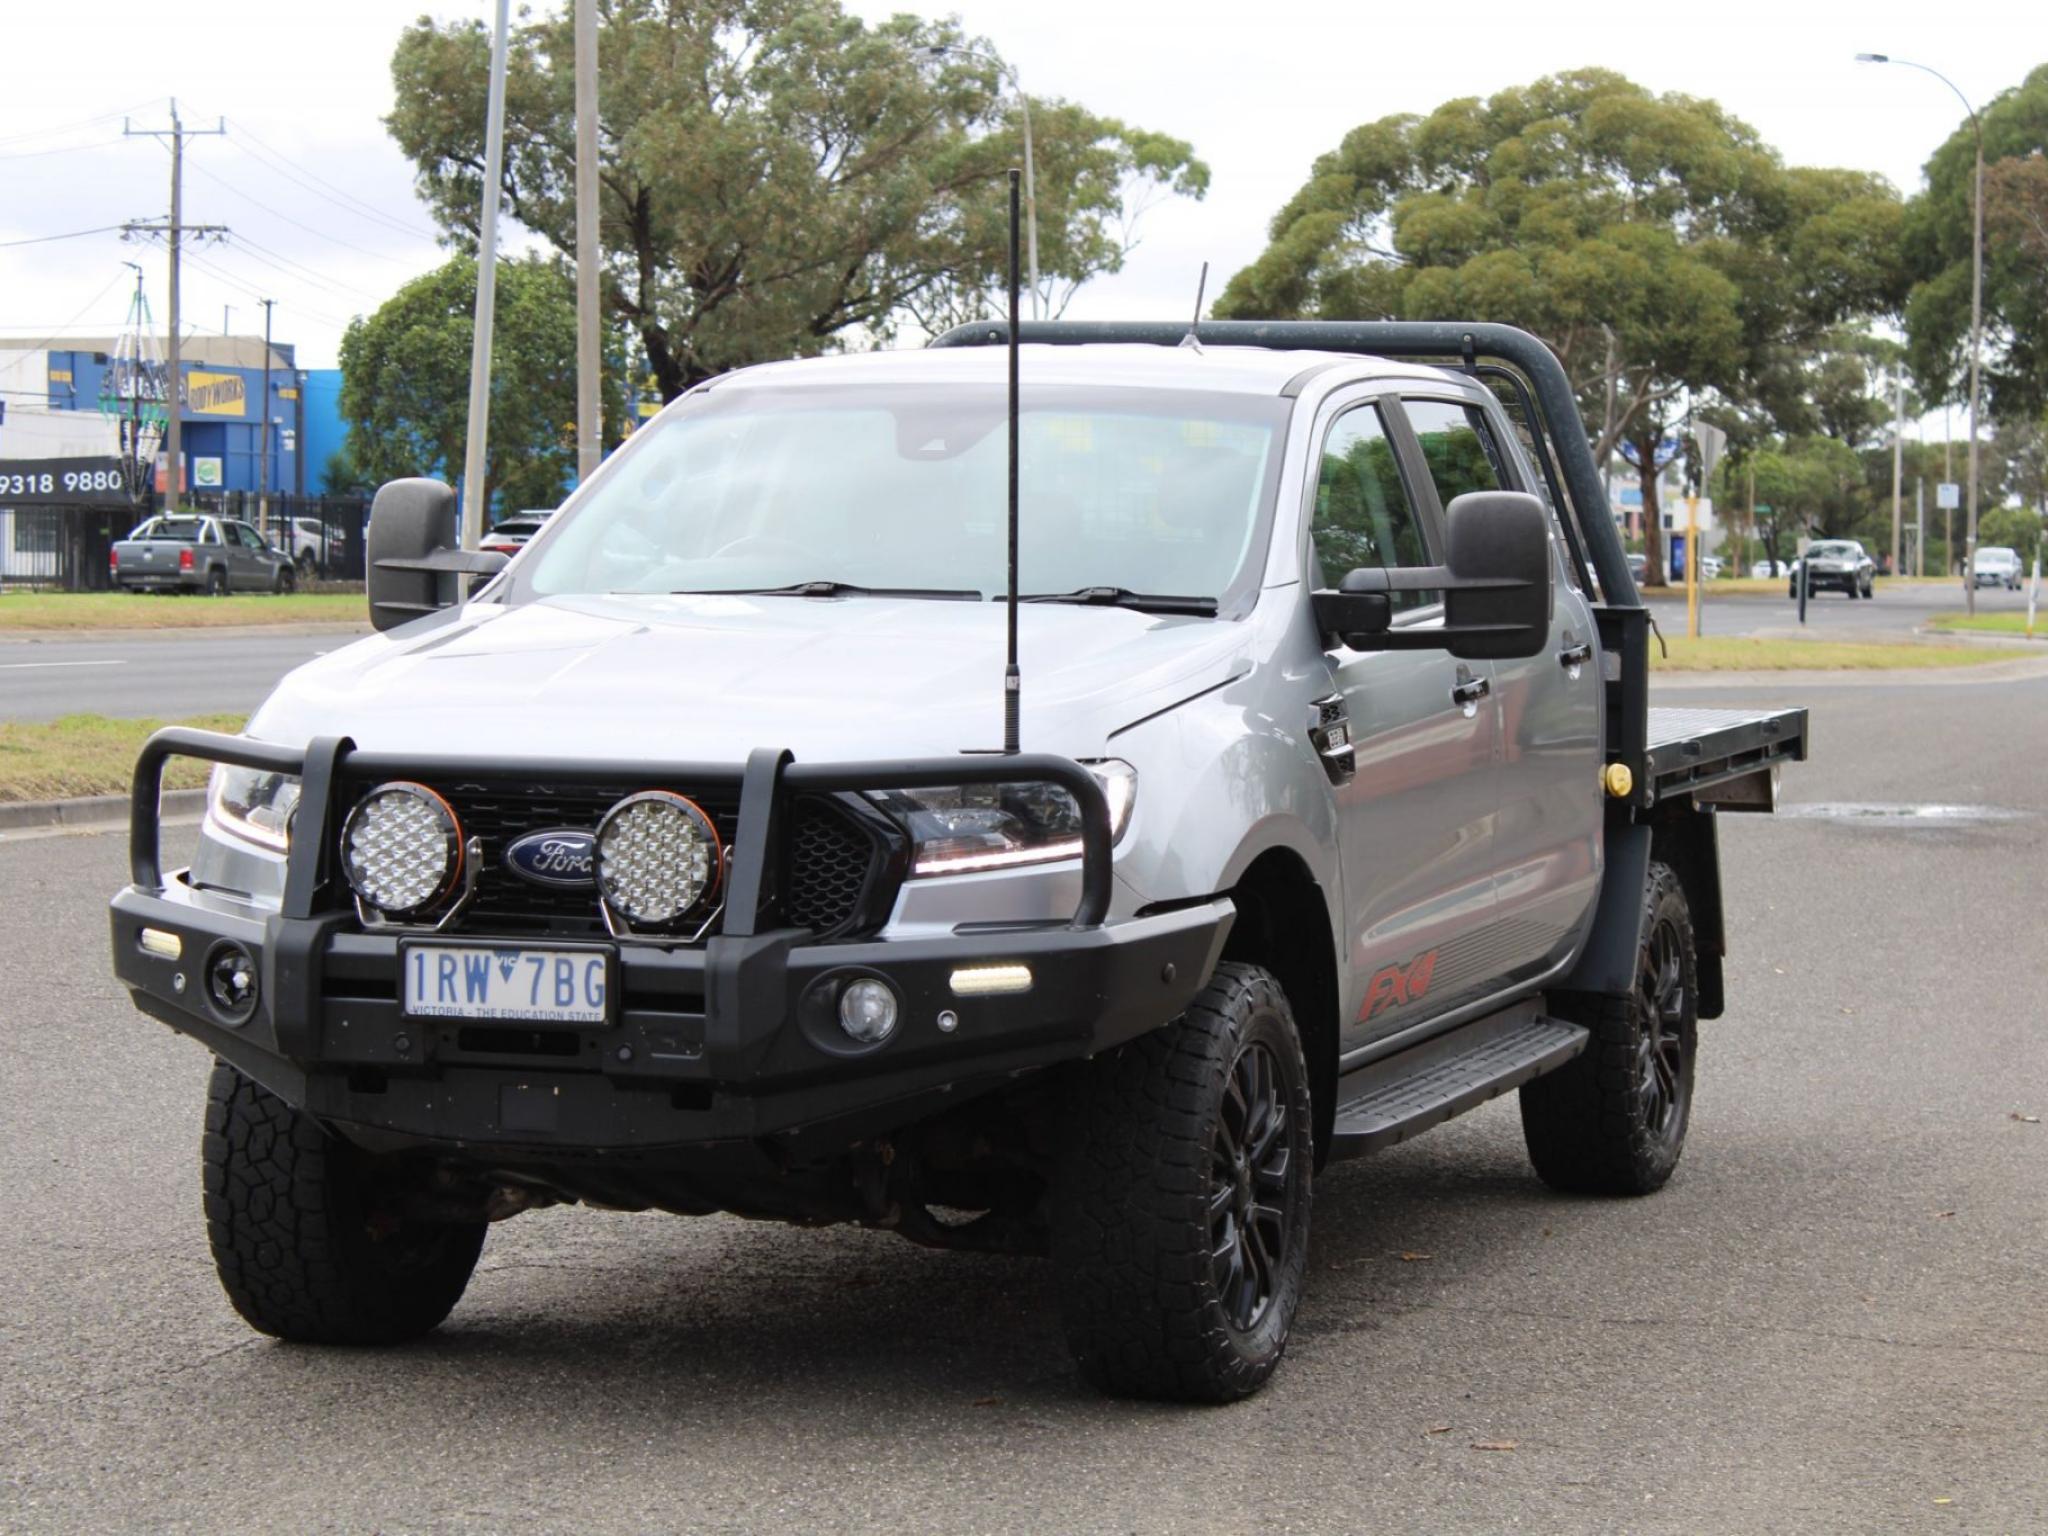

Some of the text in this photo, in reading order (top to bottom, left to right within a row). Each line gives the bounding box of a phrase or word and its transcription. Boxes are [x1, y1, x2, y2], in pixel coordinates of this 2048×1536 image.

[0, 470, 122, 495] 9318 9880
[414, 952, 605, 1008] 1RW 7BG
[1354, 949, 1440, 1023] FX4
[412, 1005, 464, 1016] VICTORIA
[476, 1007, 498, 1017] THE
[501, 1008, 563, 1020] EDUCATION
[567, 1011, 601, 1021] STATE
